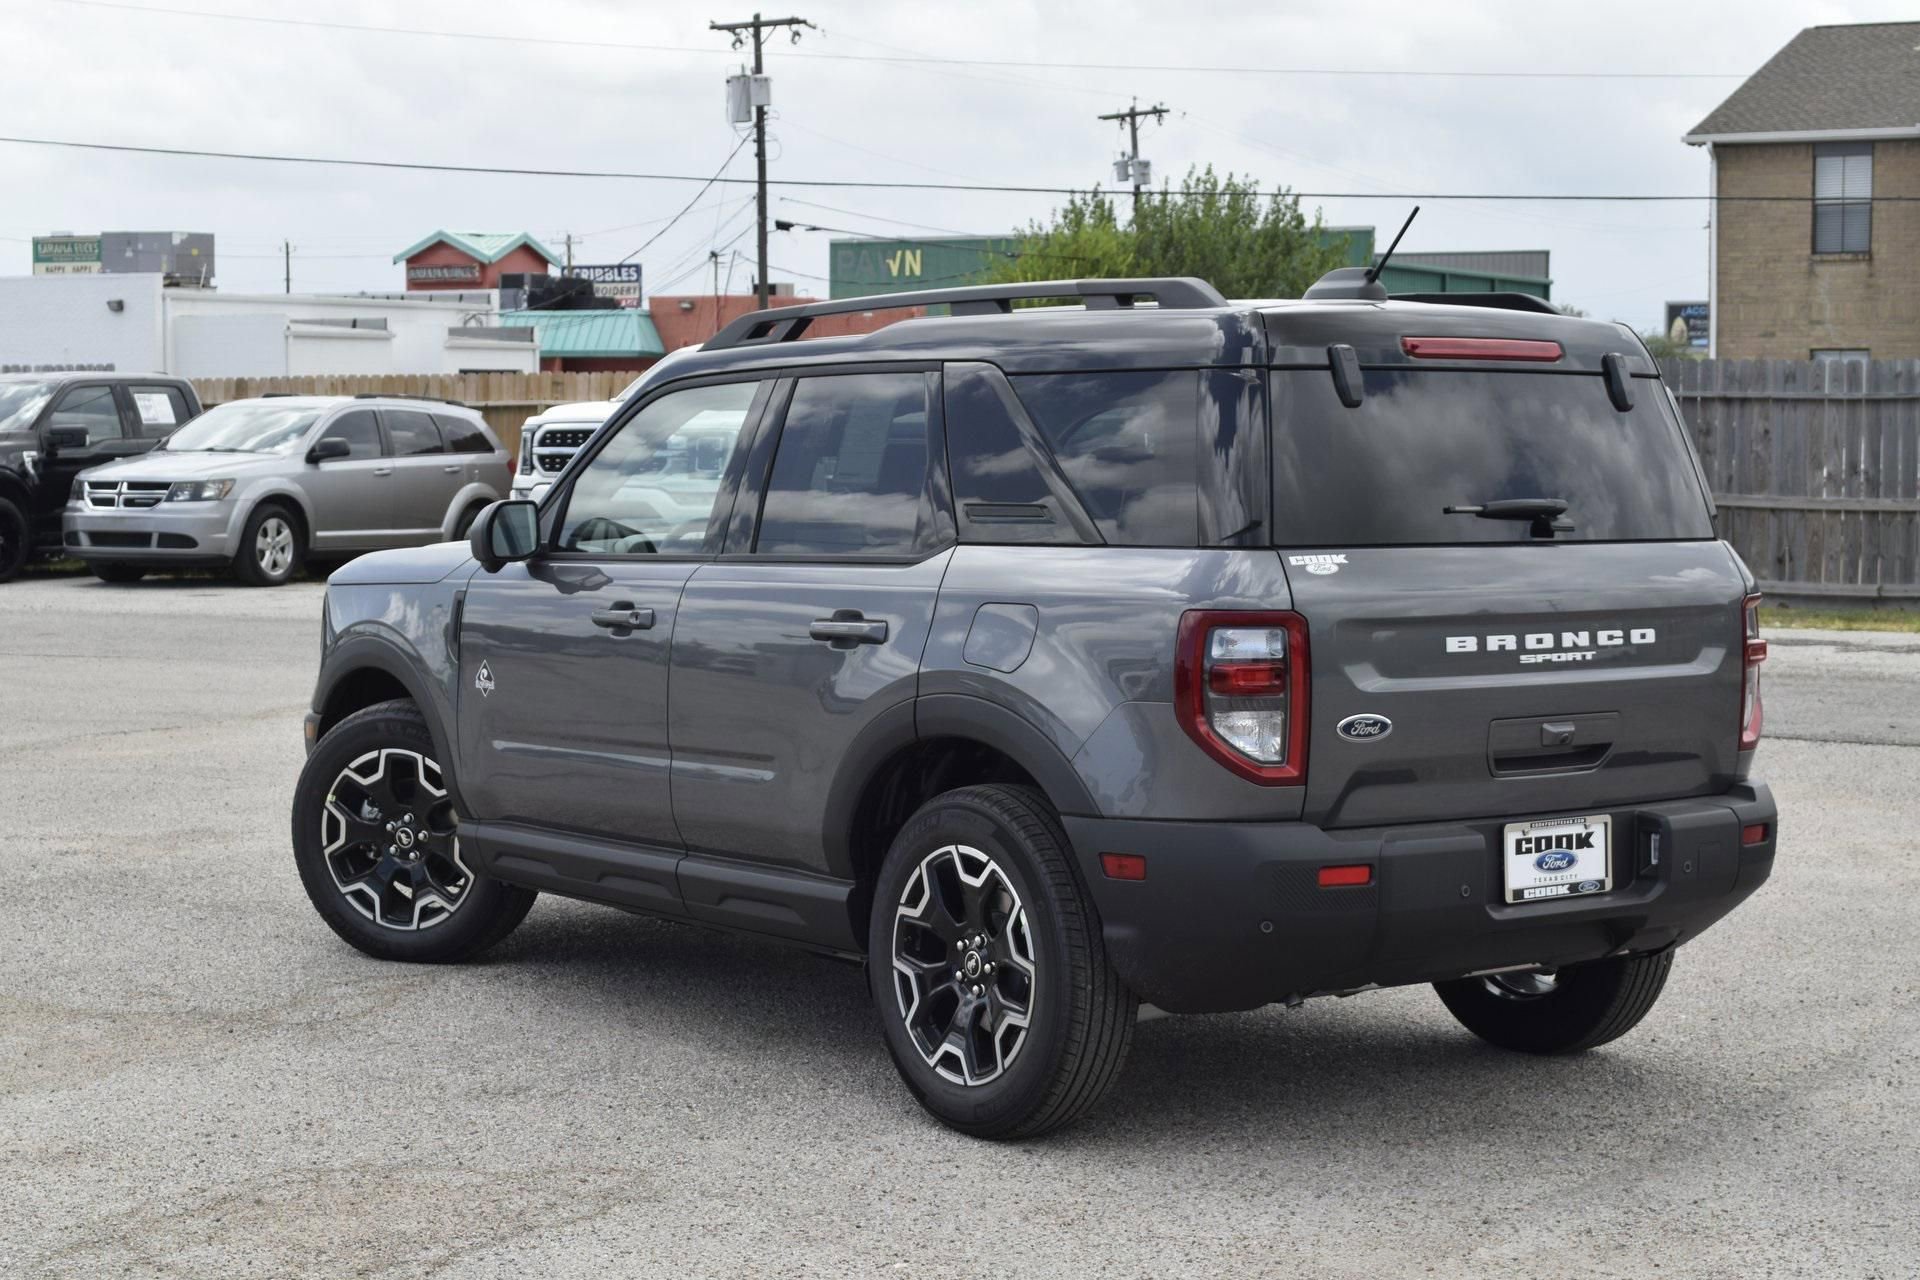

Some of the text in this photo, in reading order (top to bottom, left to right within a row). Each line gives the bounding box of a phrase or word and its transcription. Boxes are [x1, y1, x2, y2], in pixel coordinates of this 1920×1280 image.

[1288, 553, 1349, 566] COOK
[1445, 628, 1656, 653] BRONCO
[1519, 651, 1597, 664] SPORT
[1349, 719, 1382, 736] Ford
[1515, 831, 1595, 856] COOK
[1542, 853, 1569, 869] Ford
[1534, 873, 1578, 883] TEXAS CITY
[1523, 883, 1571, 899] COOK
